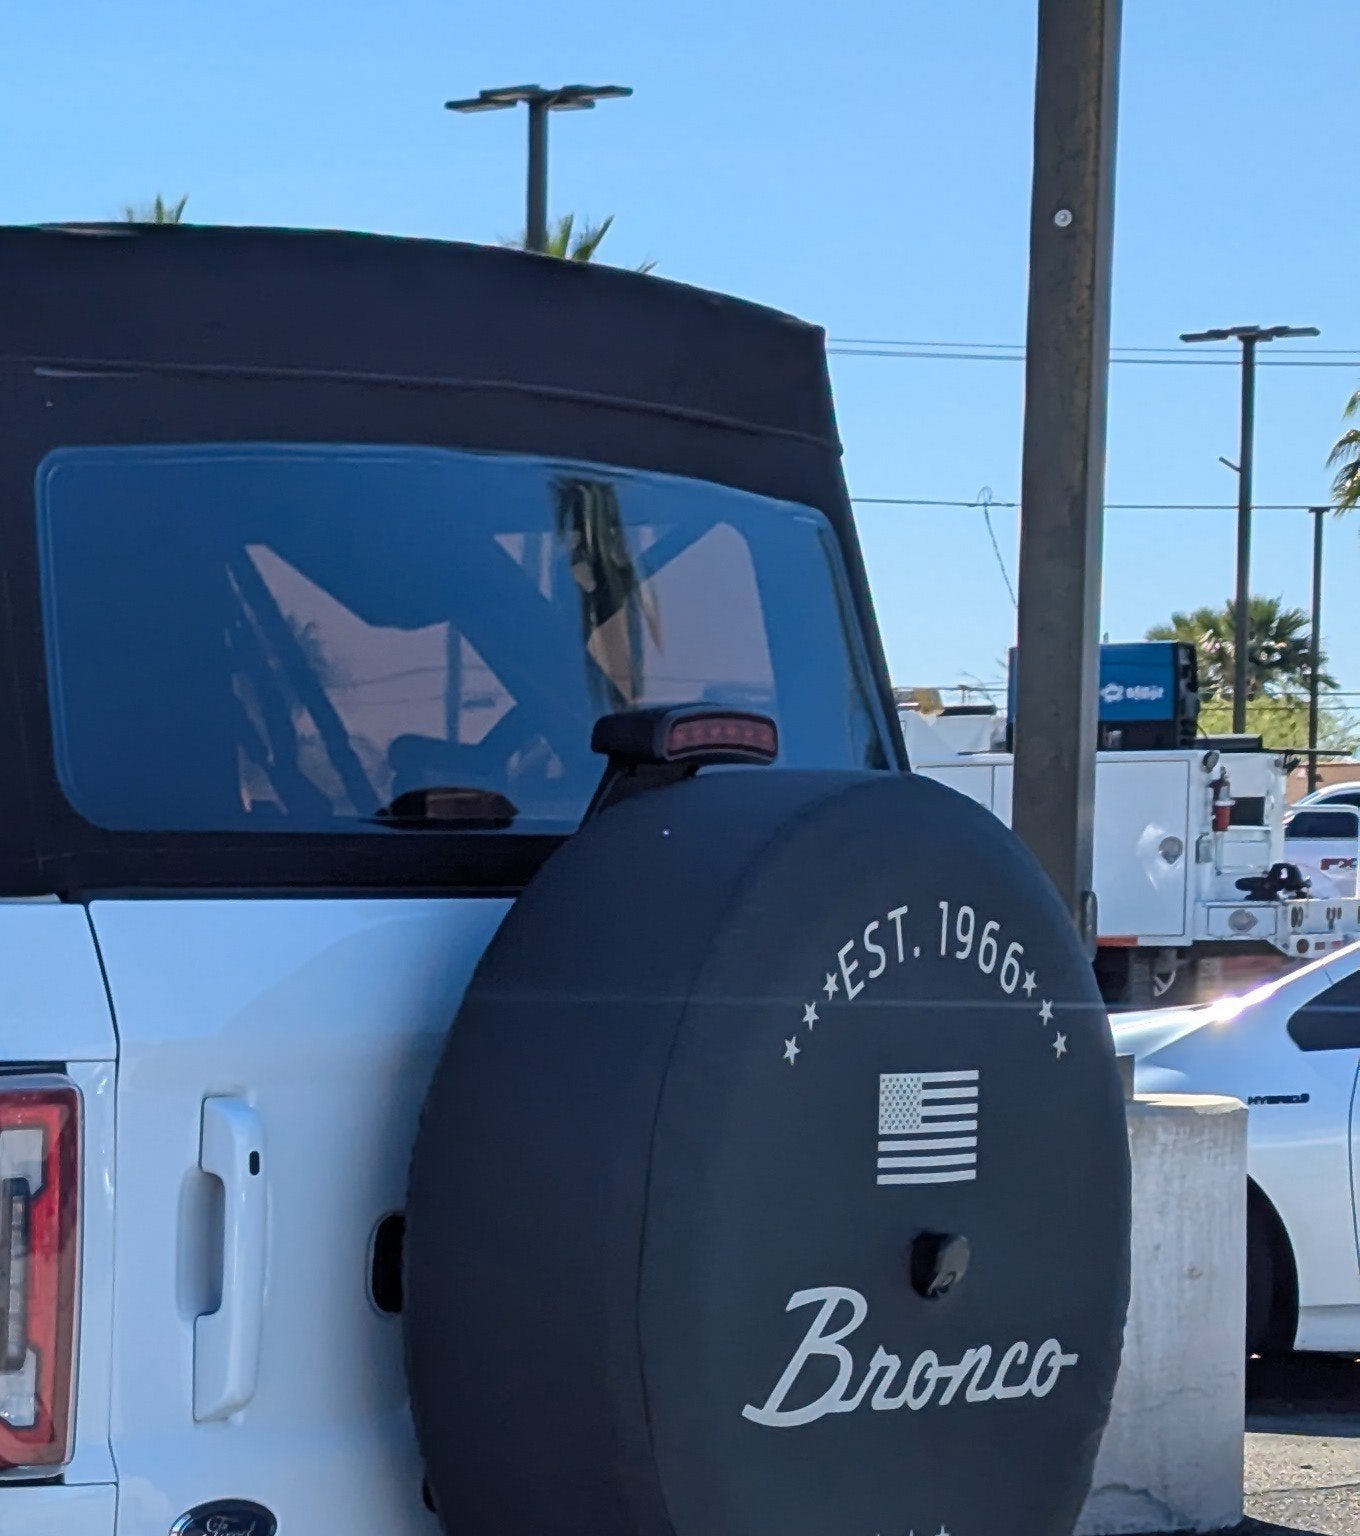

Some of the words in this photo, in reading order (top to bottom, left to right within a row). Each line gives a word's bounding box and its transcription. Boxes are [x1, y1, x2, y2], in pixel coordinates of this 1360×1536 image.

[837, 905, 923, 1000] EST.
[939, 901, 1025, 994] 1966
[742, 1286, 1079, 1428] Bronco
